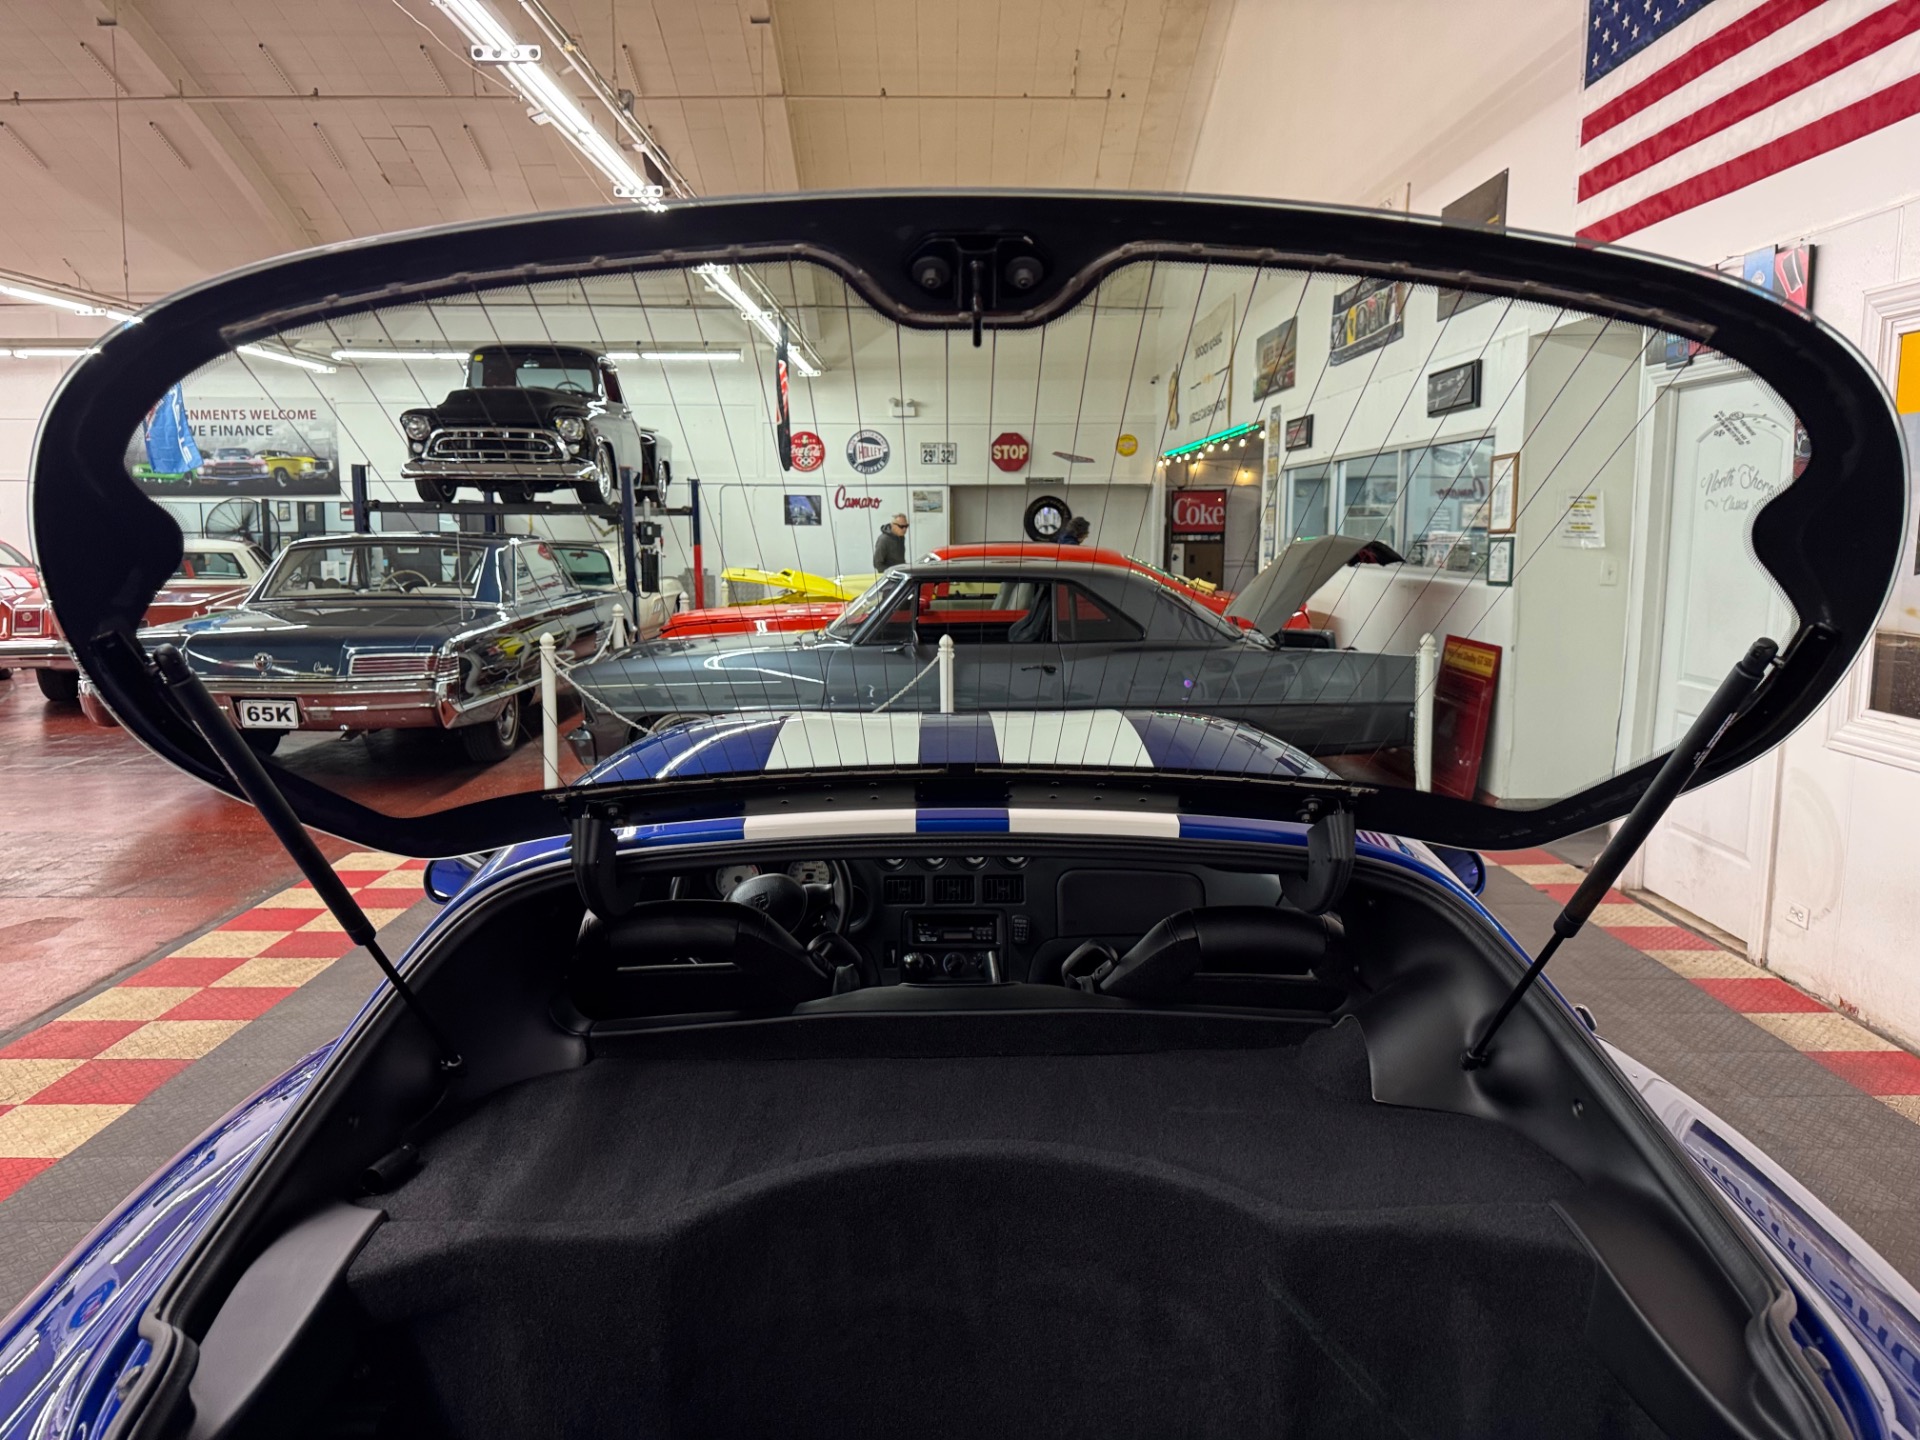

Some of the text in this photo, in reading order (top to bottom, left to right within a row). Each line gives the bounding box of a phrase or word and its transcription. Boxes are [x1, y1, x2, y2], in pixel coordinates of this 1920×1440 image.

[250, 409, 317, 420] WELCOME
[210, 425, 274, 437] FINANCE
[858, 445, 882, 460] HOLLEY
[993, 445, 1028, 460] STOP
[834, 484, 882, 510] Camaro
[1172, 498, 1225, 526] Coke
[246, 706, 293, 723] 65K
